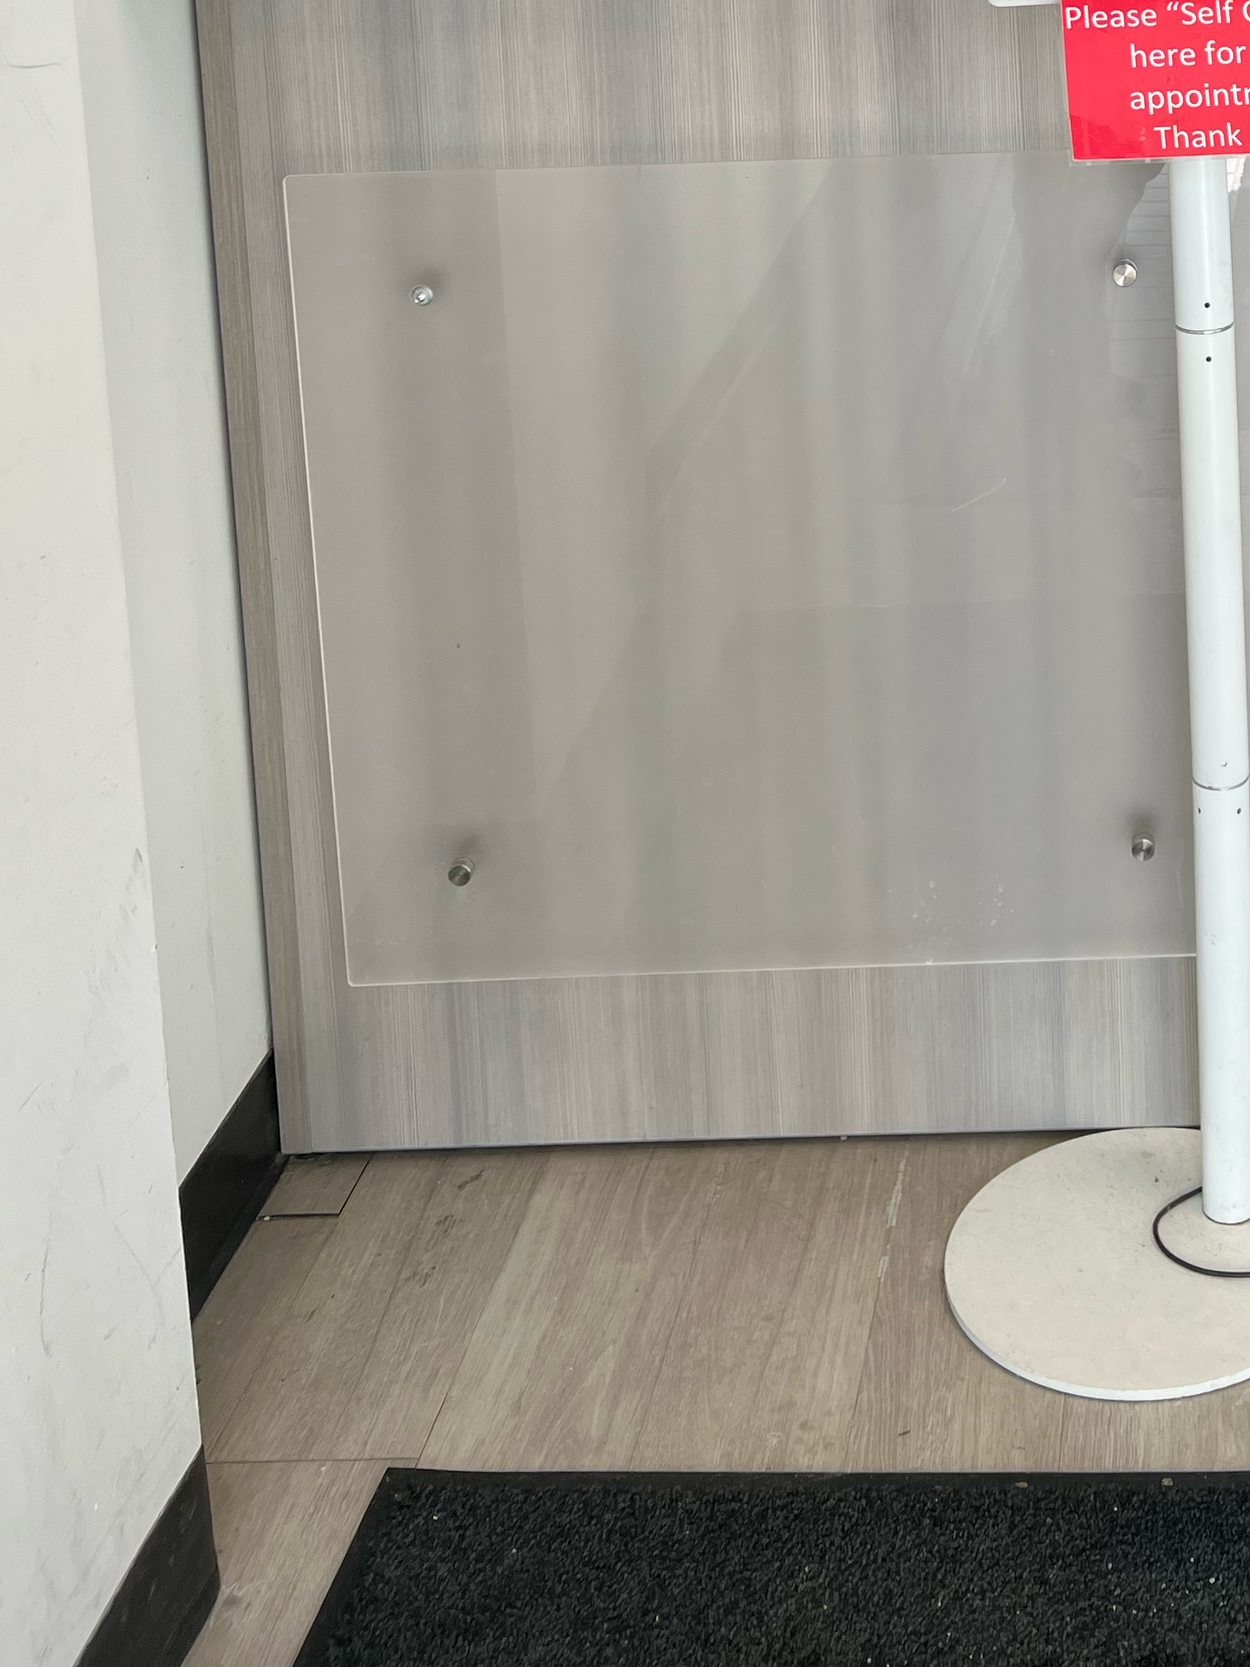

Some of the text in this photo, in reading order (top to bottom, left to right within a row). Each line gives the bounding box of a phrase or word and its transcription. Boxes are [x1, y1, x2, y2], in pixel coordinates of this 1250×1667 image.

[1065, 6, 1157, 29] Please
[1130, 43, 1196, 67] here
[1204, 40, 1246, 65] for
[1153, 122, 1243, 149] Thank
